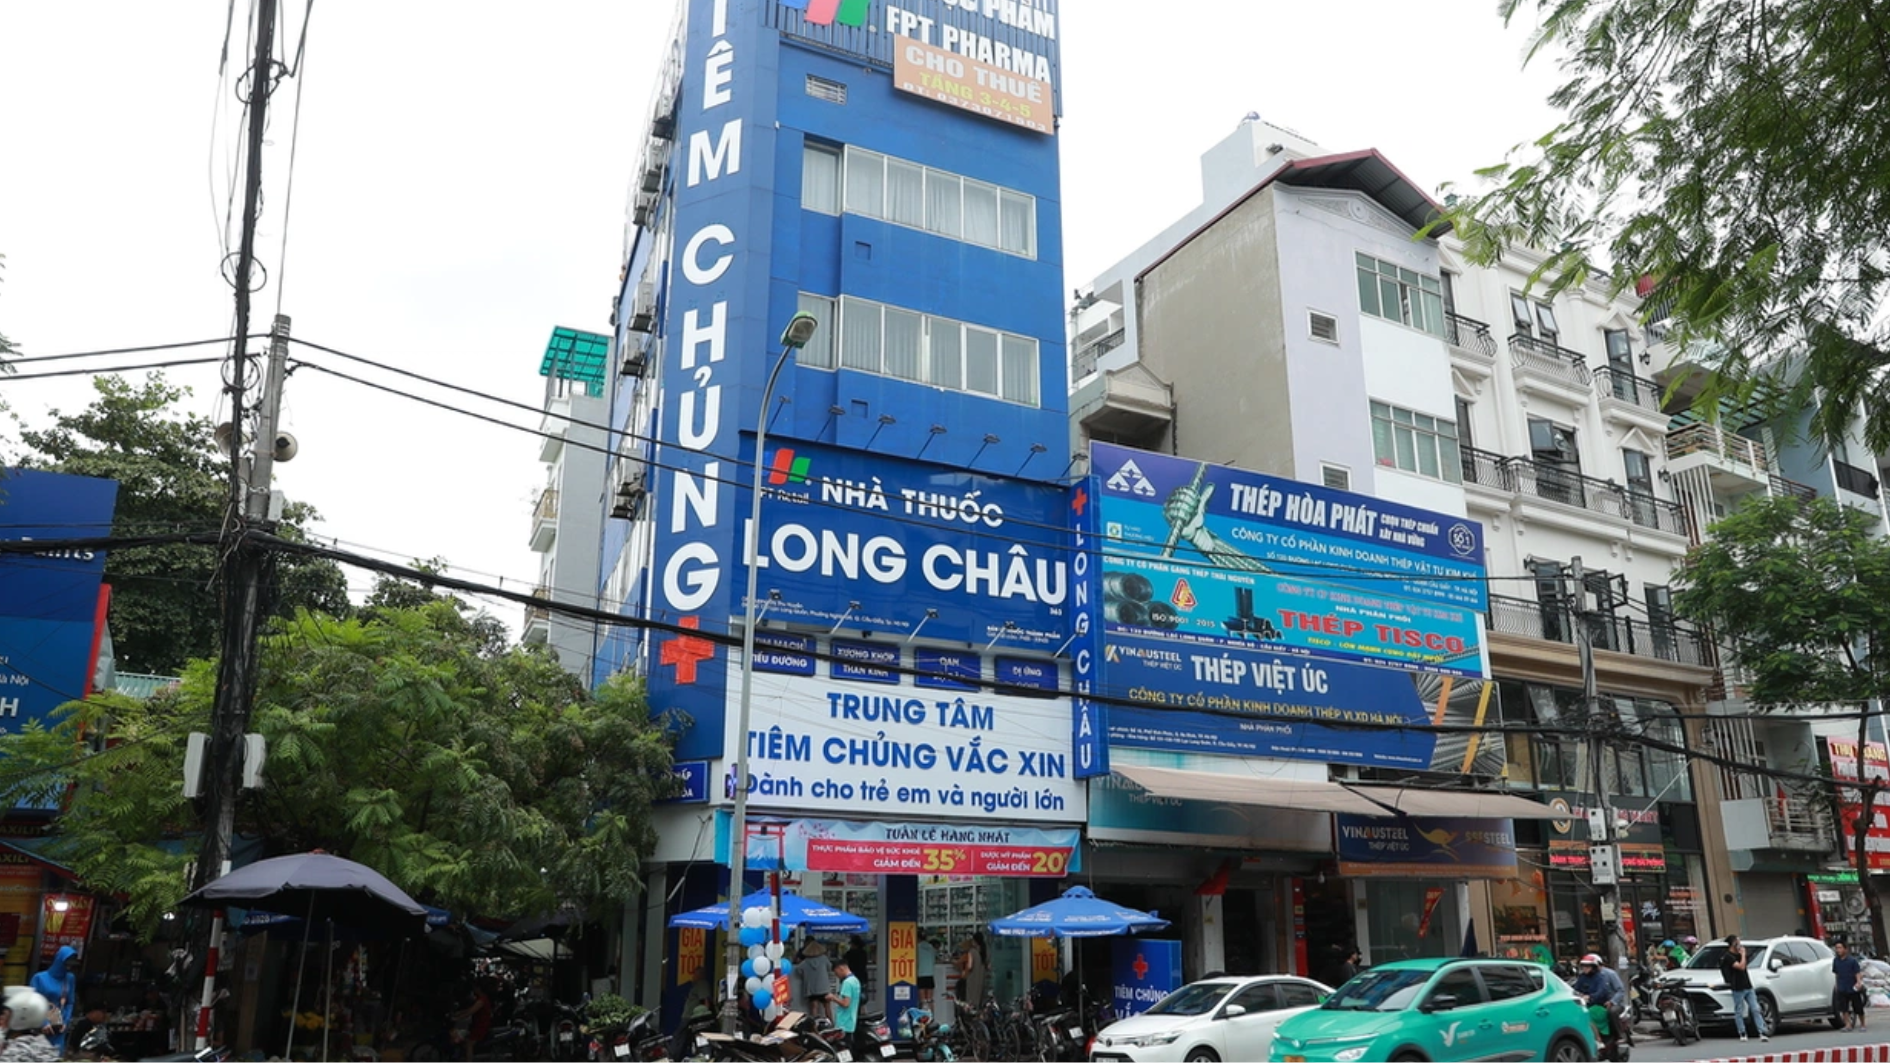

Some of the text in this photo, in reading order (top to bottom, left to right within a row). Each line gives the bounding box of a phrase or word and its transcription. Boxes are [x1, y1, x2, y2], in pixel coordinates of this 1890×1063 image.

[887, 5, 1052, 84] FPT PHARMA
[906, 45, 1042, 104] CHO THUÊ
[980, 91, 1032, 118] 3-4-5
[822, 476, 1004, 529] NHÀ THUỐC
[1230, 482, 1377, 537] THÉP HÒA PHÁT
[743, 518, 1068, 606] LONG CHÂU
[1126, 559, 1136, 567] TY
[1148, 561, 1169, 572] PHẦN
[1231, 527, 1264, 544] CÔNG
[1266, 534, 1278, 546] TY
[1280, 532, 1295, 549] CỔ
[1299, 537, 1327, 553] PHẦN
[1328, 544, 1354, 559] KINH
[1355, 550, 1390, 566] DOANH
[1390, 556, 1413, 569] THÉP
[1152, 612, 1167, 622] ISO
[1277, 608, 1364, 637] THÉP
[1374, 624, 1465, 654] TISCO
[771, 653, 808, 668] ĐƯỜNG
[837, 648, 868, 660] XƯƠNG
[1074, 523, 1092, 769] LONG CHÂU
[1191, 653, 1247, 685] THÉP
[1251, 658, 1296, 695] VIỆT
[1302, 662, 1329, 694] ÚC
[827, 692, 994, 731] TRUNG TÂM
[1129, 686, 1166, 703] CÔNG
[1169, 692, 1184, 704] TY
[1207, 694, 1241, 710] PHẦN
[1243, 701, 1271, 714] KINH
[1273, 702, 1313, 717] DOANH
[1315, 704, 1342, 719] THÉP
[746, 725, 1066, 779] TIÊM CHỦNG VẮC XIN
[745, 771, 802, 797] Dành
[811, 777, 854, 800] cho
[861, 774, 890, 802] trẻ
[896, 787, 931, 805] em
[937, 778, 965, 807] và
[971, 782, 1029, 813] người
[1034, 783, 1065, 811] lớn
[873, 857, 921, 869] GIẢM ĐẾN
[922, 848, 967, 872] 35%
[986, 860, 1031, 872] GIẢM ĐẾN
[890, 924, 915, 949] GIÁ
[890, 952, 915, 978] TỐT
[1114, 984, 1134, 1000] TIÊM
